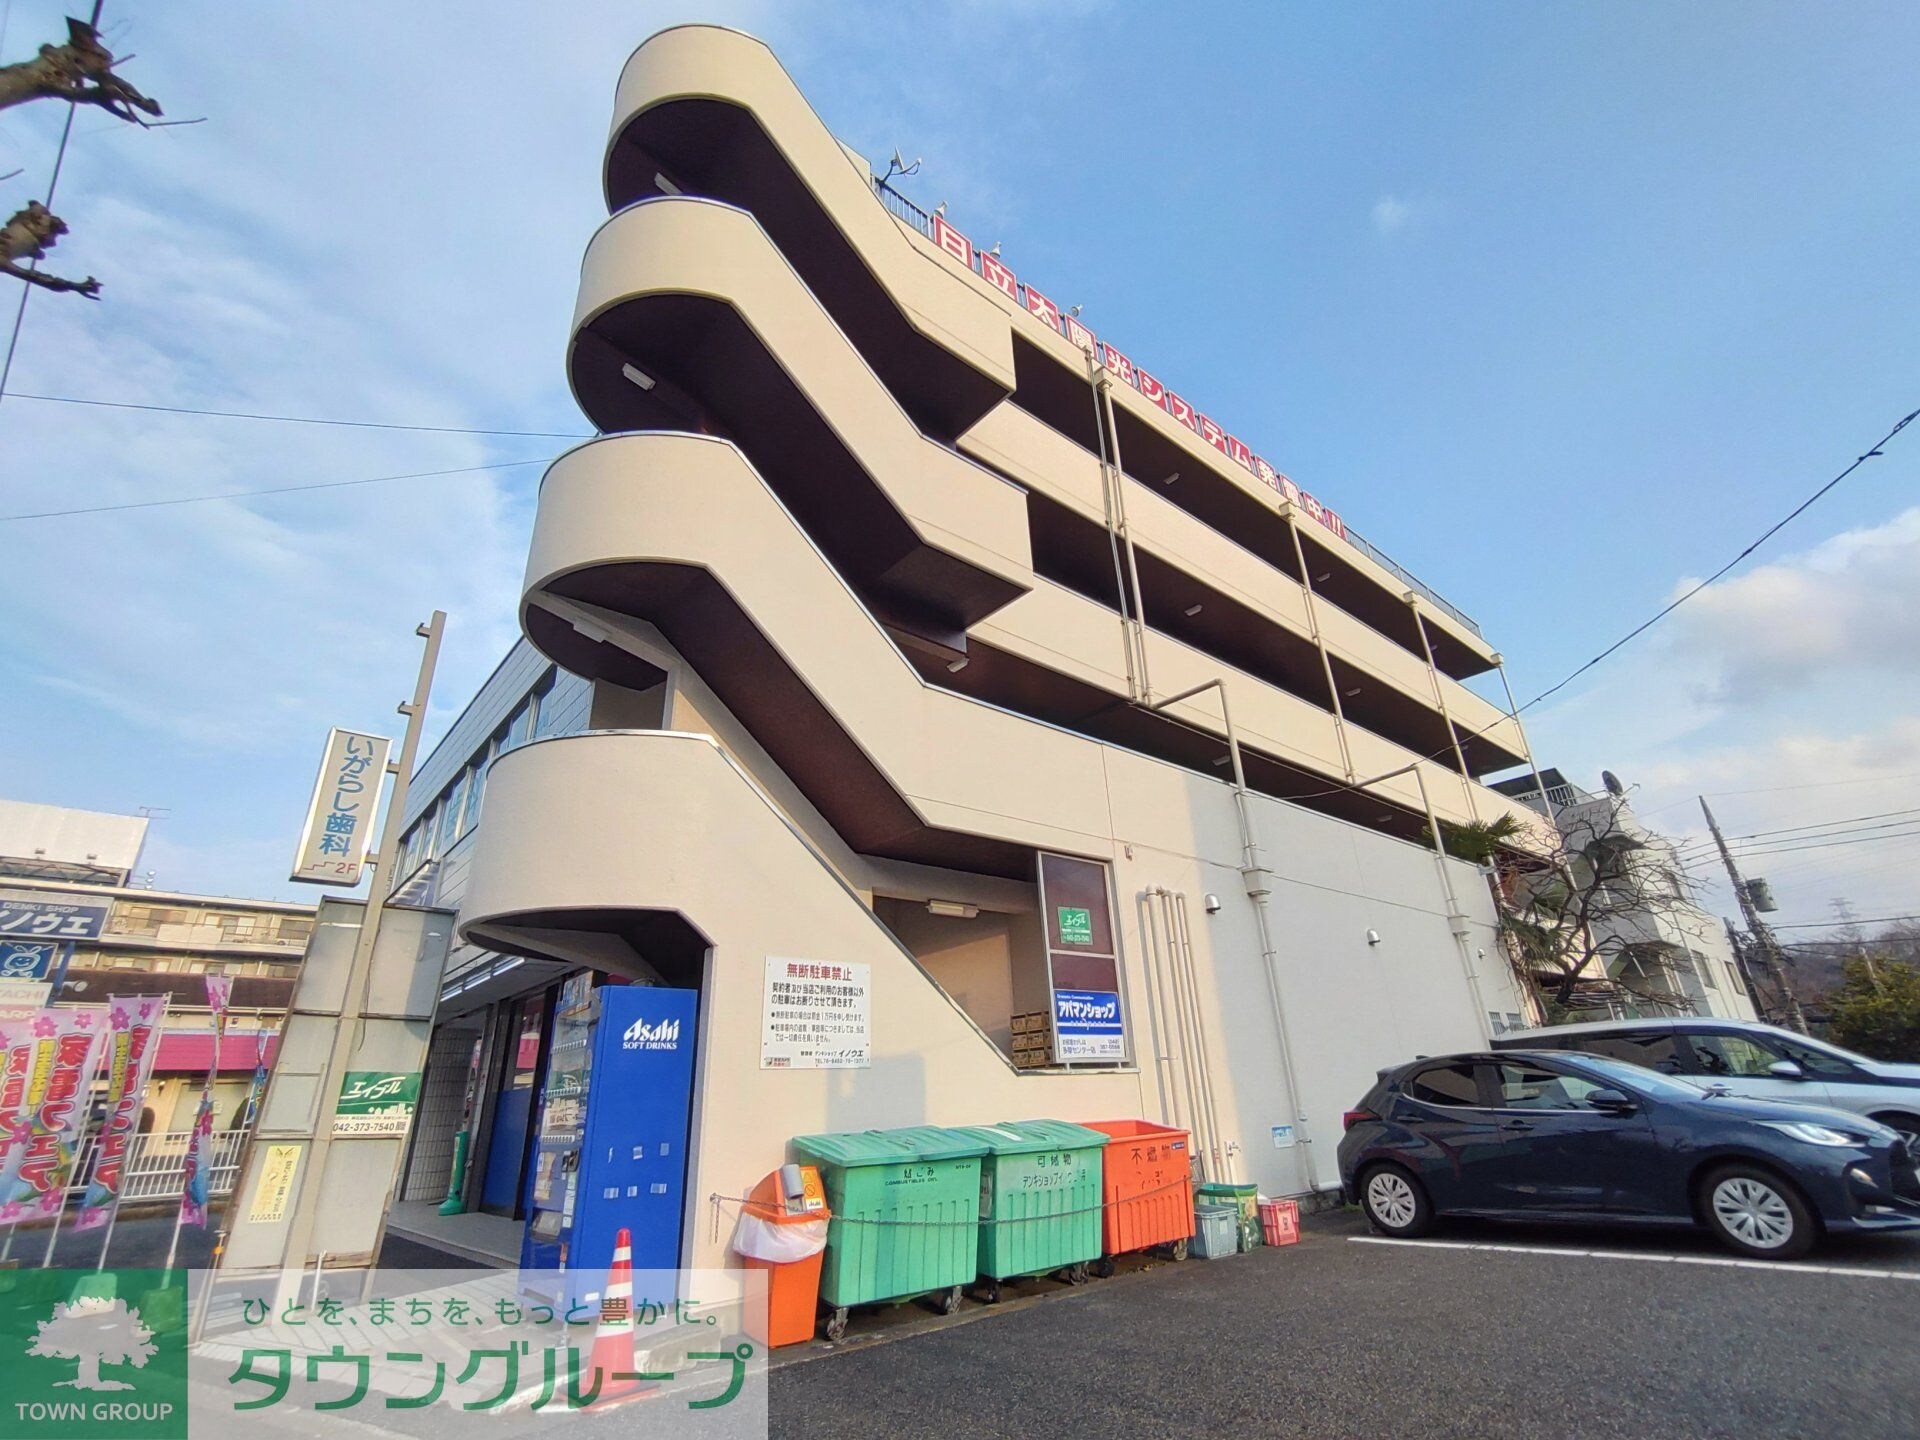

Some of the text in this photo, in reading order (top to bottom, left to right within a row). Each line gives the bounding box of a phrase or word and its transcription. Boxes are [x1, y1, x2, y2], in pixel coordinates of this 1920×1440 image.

[319, 735, 374, 858] いがらし歯科
[335, 862, 357, 874] 2F
[3, 902, 79, 914] DENKI SHOP
[786, 963, 852, 982] 無断駐車禁止
[772, 982, 864, 997] 契約者及び当店ご利用のお客様以外
[771, 996, 857, 1008] の駐車はお断りさせて頂きます。
[1058, 1001, 1115, 1018] アパマンショップ
[623, 1017, 680, 1041] Asahi
[623, 1041, 677, 1050] SOFT DRINKS
[838, 1049, 864, 1057] イノウエ
[340, 1076, 406, 1099] エイブル
[332, 1123, 395, 1132] 042-373-7540
